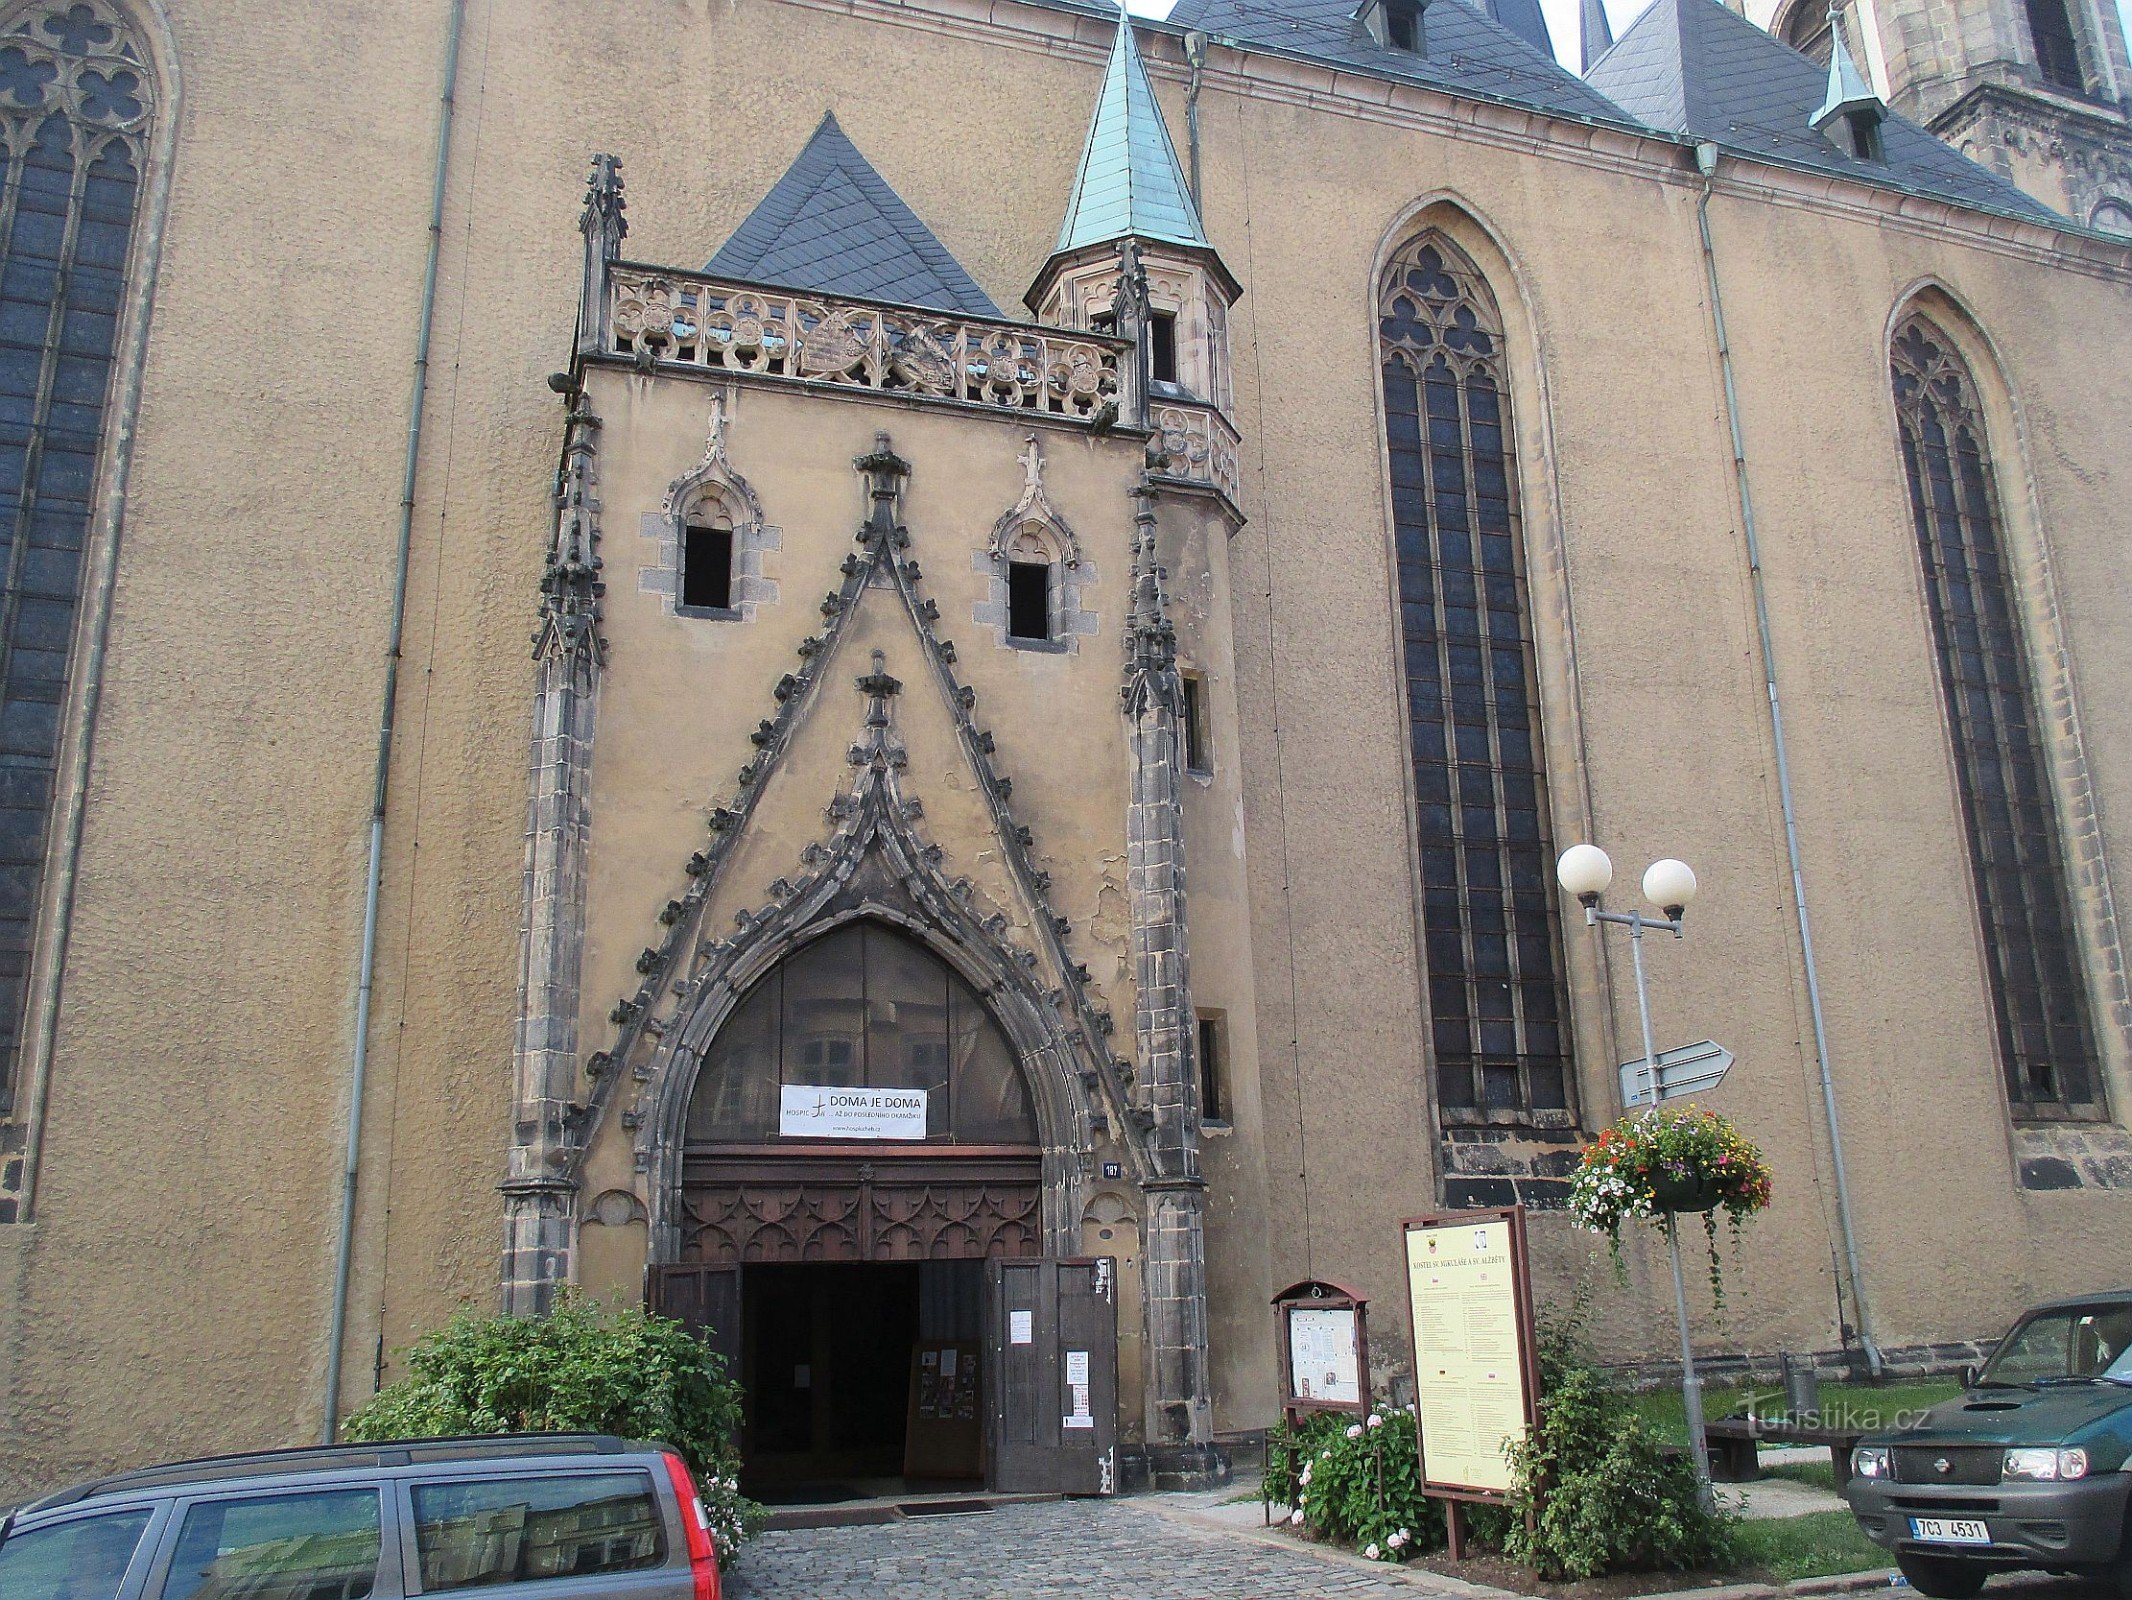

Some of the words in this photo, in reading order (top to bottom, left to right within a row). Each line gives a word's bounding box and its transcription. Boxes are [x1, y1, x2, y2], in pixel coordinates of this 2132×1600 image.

[830, 1095, 867, 1107] DOMA
[870, 1097, 881, 1108] JE
[885, 1097, 921, 1109] DOMA
[786, 1109, 810, 1117] HOSPIC
[1919, 1520, 1942, 1536] 7C3
[1950, 1522, 1982, 1538] 4531
